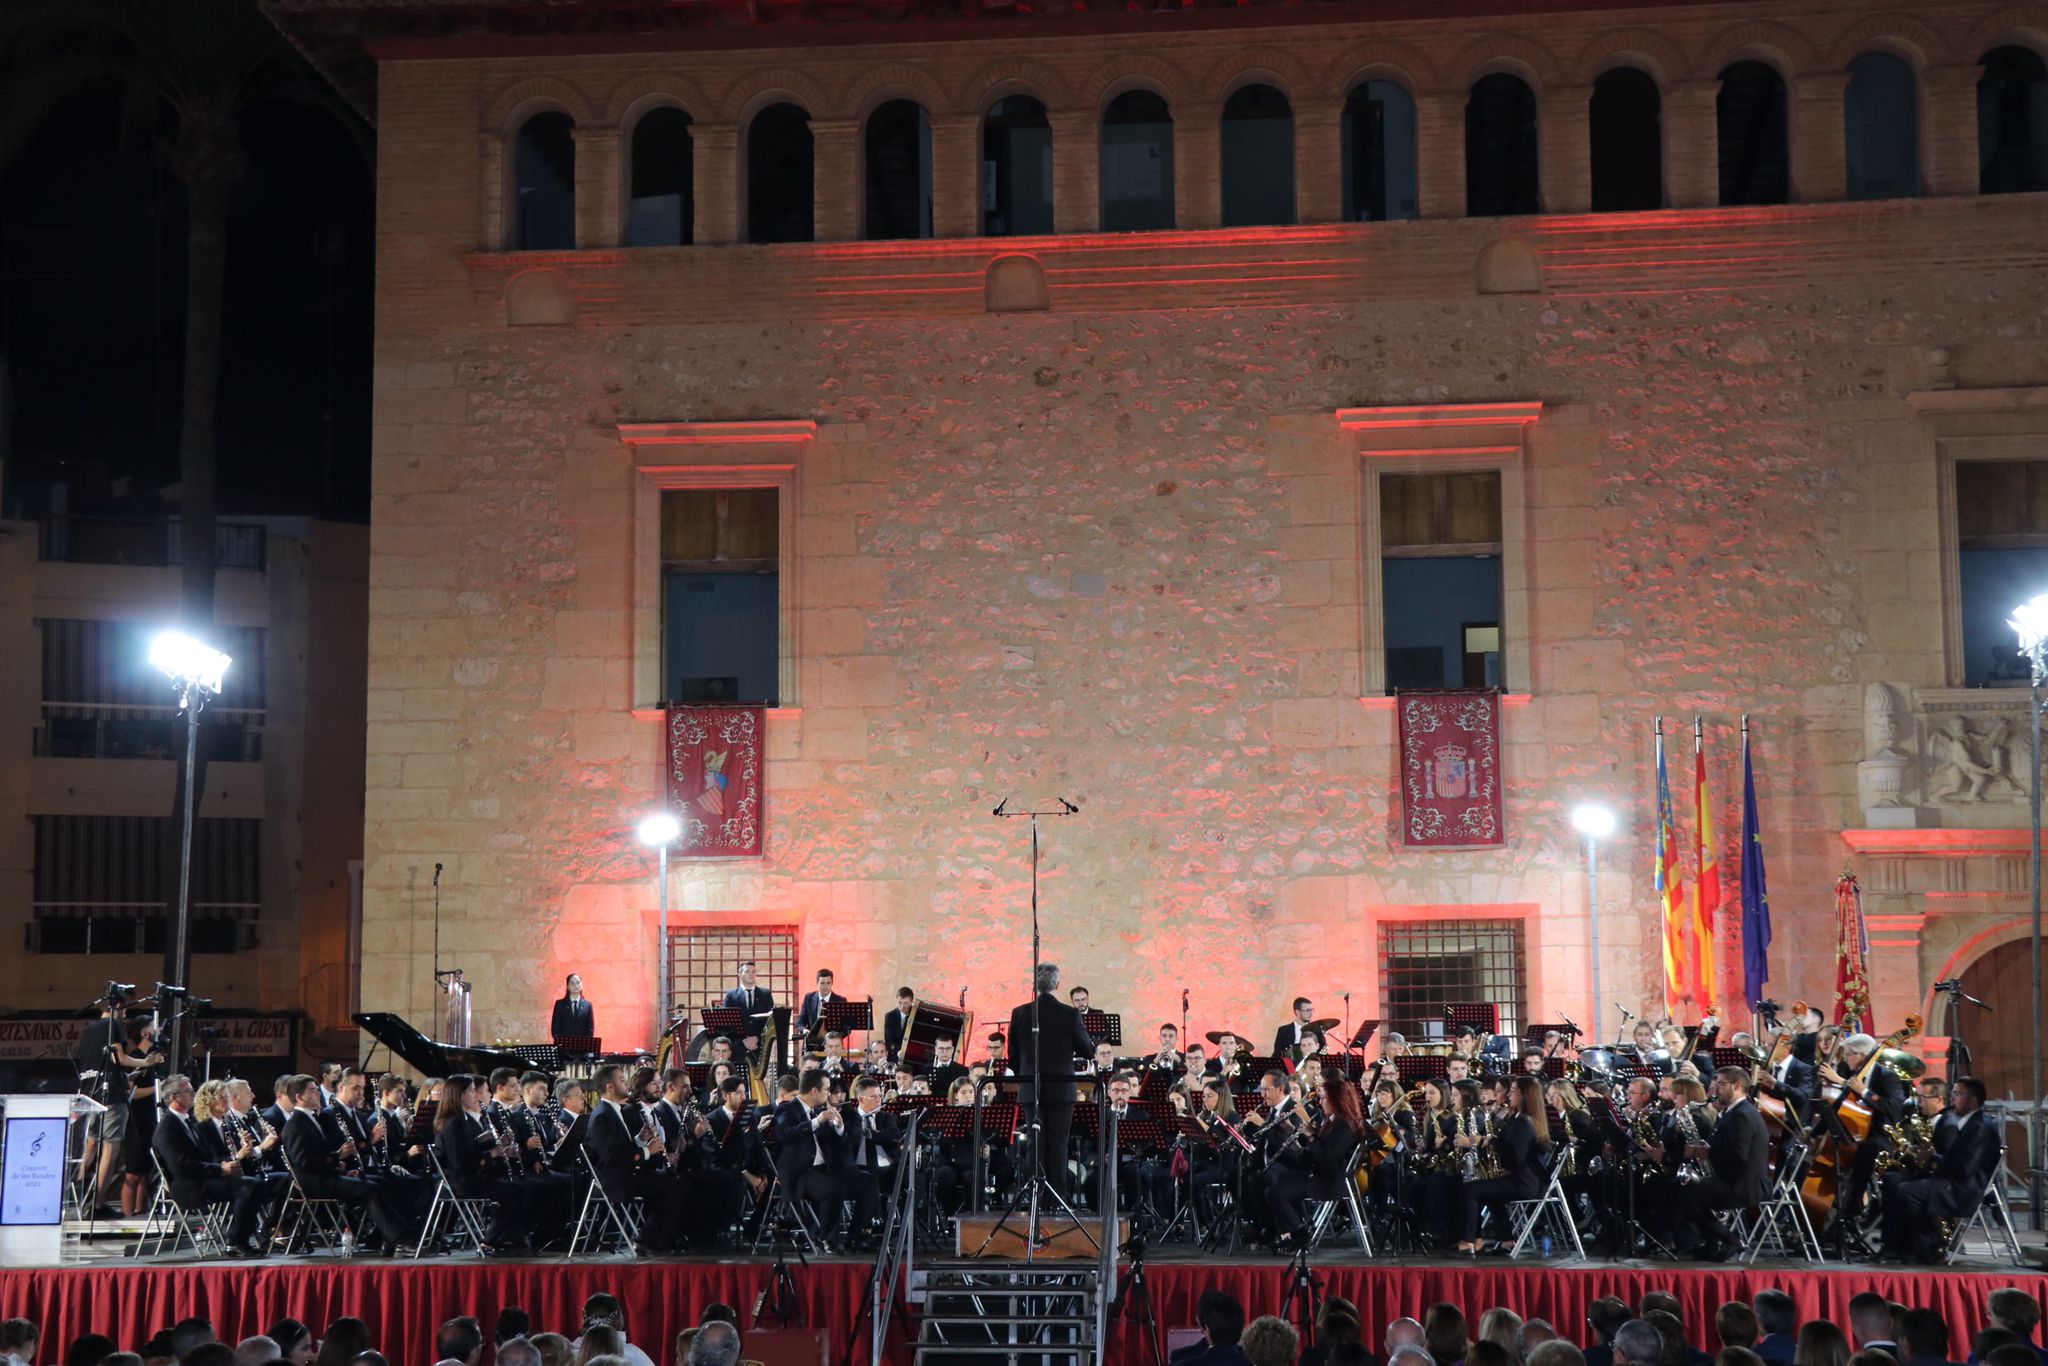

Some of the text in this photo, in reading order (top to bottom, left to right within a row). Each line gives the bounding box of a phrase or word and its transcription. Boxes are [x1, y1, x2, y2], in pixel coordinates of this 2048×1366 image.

[66, 1023, 80, 1041] de
[233, 1020, 244, 1038] la
[247, 1019, 288, 1038] CARNE
[0, 1046, 31, 1056] casa
[208, 1039, 273, 1055] illanueva
